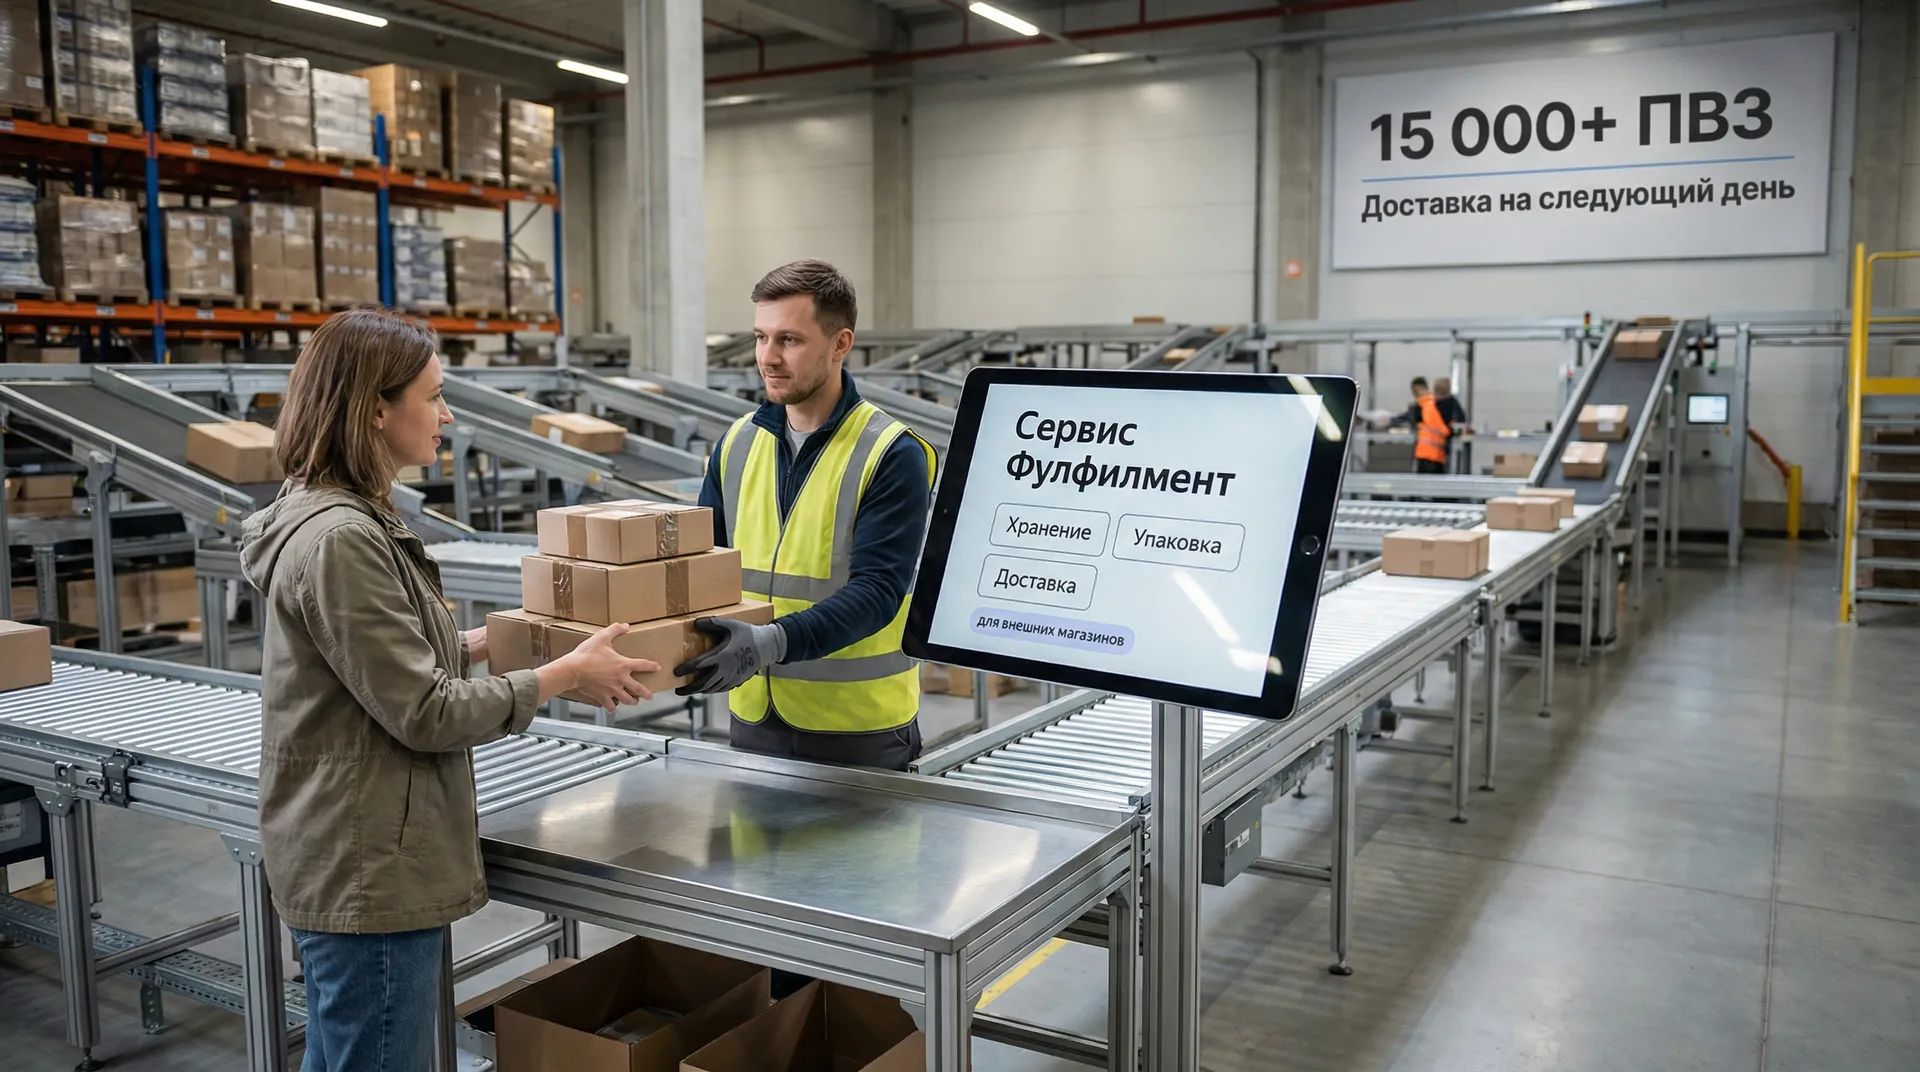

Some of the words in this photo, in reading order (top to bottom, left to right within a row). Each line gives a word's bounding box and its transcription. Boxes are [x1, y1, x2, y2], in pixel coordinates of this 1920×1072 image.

[1370, 110, 1434, 161] 15
[1451, 101, 1617, 157] 000+
[1638, 86, 1774, 146] ПВЗ
[1361, 194, 1492, 223] Доставка
[1500, 192, 1531, 212] на
[1539, 177, 1714, 213] следующий
[1720, 179, 1796, 207] день
[1015, 410, 1138, 449] Сервис
[1006, 450, 1237, 497] Фулфилмент
[1005, 515, 1092, 541] Хранение
[1133, 528, 1222, 555] Упаковка
[993, 568, 1077, 595] Доставка
[976, 616, 1000, 629] для
[1001, 619, 1056, 638] внешних
[1057, 627, 1125, 648] магазинов
